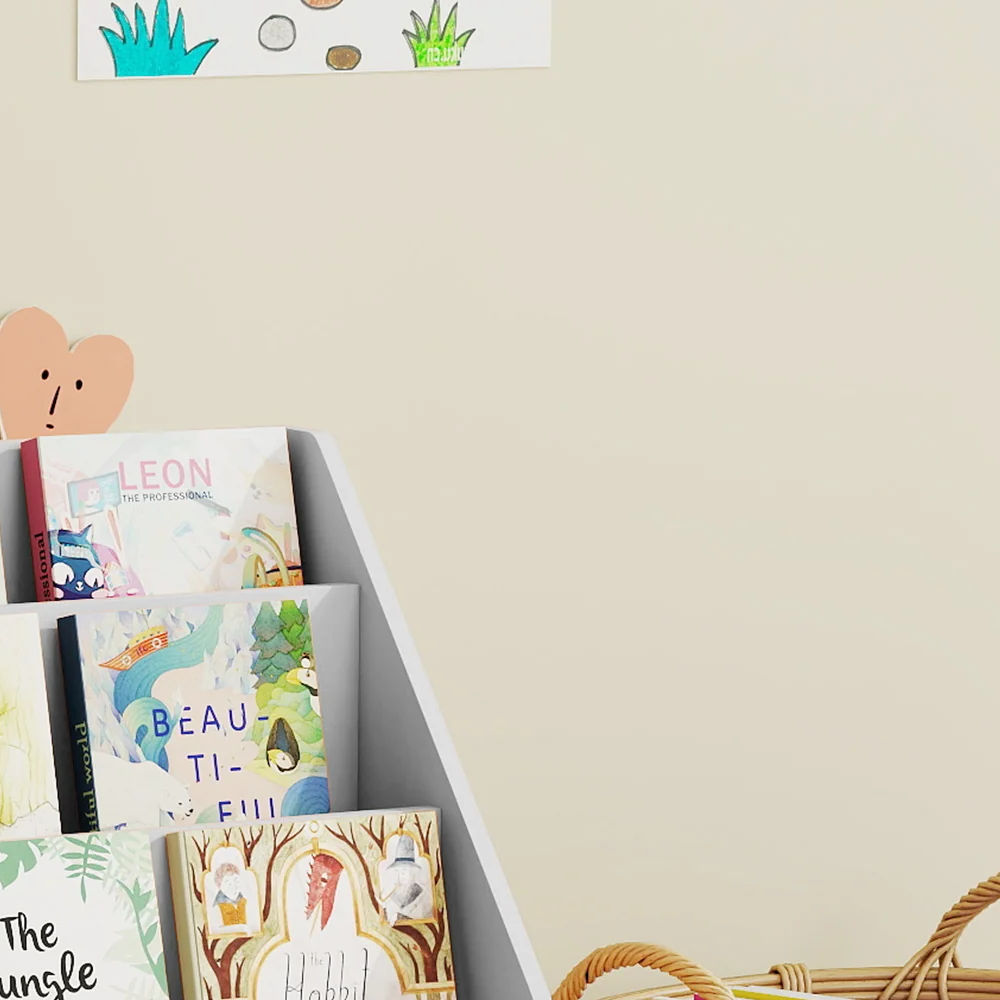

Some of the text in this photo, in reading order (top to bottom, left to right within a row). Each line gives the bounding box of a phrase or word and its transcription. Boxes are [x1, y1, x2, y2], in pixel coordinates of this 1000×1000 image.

[118, 457, 213, 490] LEON
[121, 490, 214, 503] THE PROFESSIONAL
[33, 531, 51, 601] ssional
[152, 702, 269, 737] BEAU-
[75, 721, 93, 784] world
[187, 753, 242, 783] TI-
